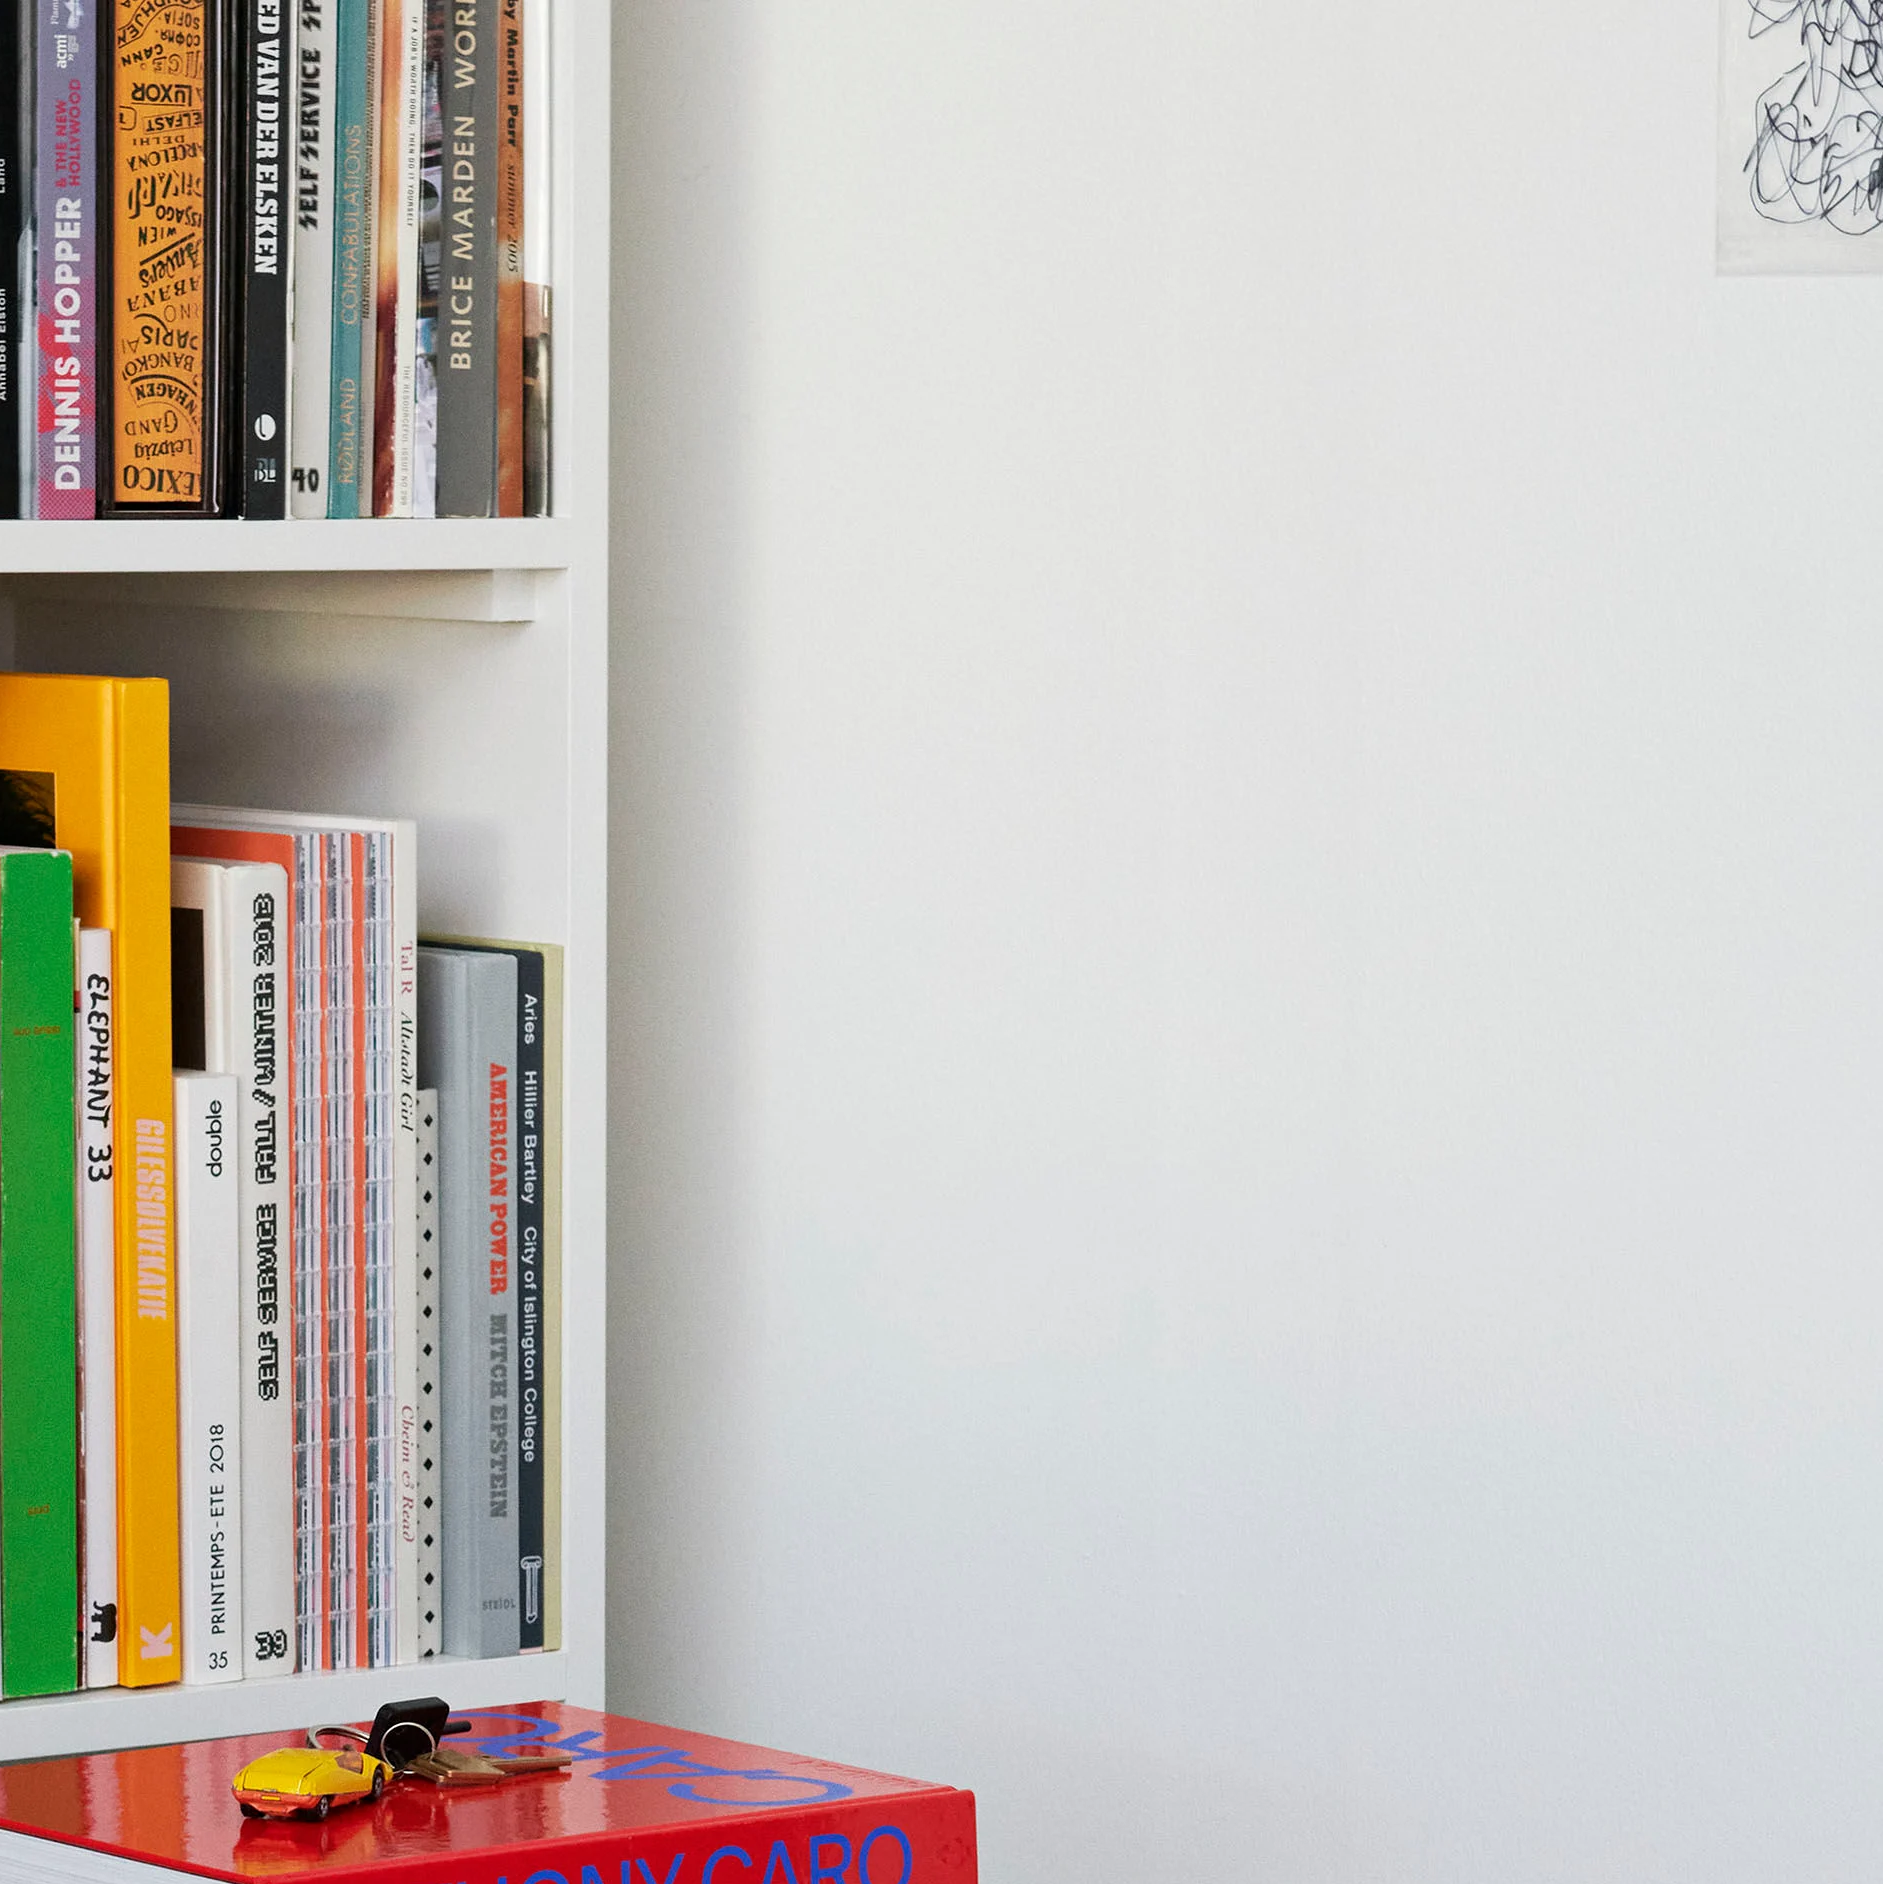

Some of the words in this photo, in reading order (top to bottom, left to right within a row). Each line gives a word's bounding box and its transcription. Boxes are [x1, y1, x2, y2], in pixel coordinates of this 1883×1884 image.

[54, 34, 67, 69] acmi
[256, 38, 280, 99] VAN
[507, 28, 519, 95] Martin
[54, 99, 67, 132] NEW
[131, 82, 193, 107] LUXOR
[300, 48, 322, 165] SERVICE
[507, 104, 519, 147] Parr
[54, 143, 67, 171] THE
[68, 78, 82, 187] HOLLYWOOD
[132, 135, 185, 147] DELHI
[255, 101, 280, 160] DER
[255, 163, 279, 275] ELSKEN
[299, 168, 319, 232] SELF
[451, 115, 475, 261] MARDEN
[506, 164, 515, 229] summer
[138, 226, 177, 247] WIEN
[340, 124, 362, 325] CONFABULATIONS
[507, 235, 518, 273] 2005
[54, 197, 82, 343] HOPPER
[449, 276, 473, 370] BRICE
[54, 356, 81, 490] DENNIS
[124, 409, 178, 437] GAND
[134, 438, 194, 460] Leipzig
[291, 467, 320, 493] 40
[253, 892, 275, 967] 2013
[400, 940, 414, 971] Tal
[401, 976, 413, 996] R
[253, 972, 276, 1086] WINTER
[399, 1011, 414, 1085] Altstadt
[524, 993, 537, 1044] Aries
[86, 973, 111, 1128] ELEPHANT
[401, 1091, 414, 1132] Girl
[489, 1062, 508, 1198] AMERICAN
[524, 1070, 538, 1129] Hillier
[87, 1144, 113, 1182] 33
[205, 1100, 222, 1177] double
[255, 1111, 277, 1185] FALL
[521, 1135, 538, 1204] Bartley
[256, 1202, 278, 1325] SERVICE
[489, 1202, 509, 1296] POWER
[521, 1226, 538, 1266] City
[524, 1271, 538, 1290] of
[258, 1330, 279, 1401] SELF
[489, 1313, 508, 1399] MITCH
[521, 1293, 538, 1381] Islington
[209, 1424, 225, 1473] 2018
[401, 1405, 415, 1462] Cheim
[521, 1387, 538, 1463] College
[489, 1404, 508, 1519] EPSTEIN
[402, 1495, 415, 1543] Read
[139, 1622, 174, 1660] K
[208, 1651, 229, 1670] 35
